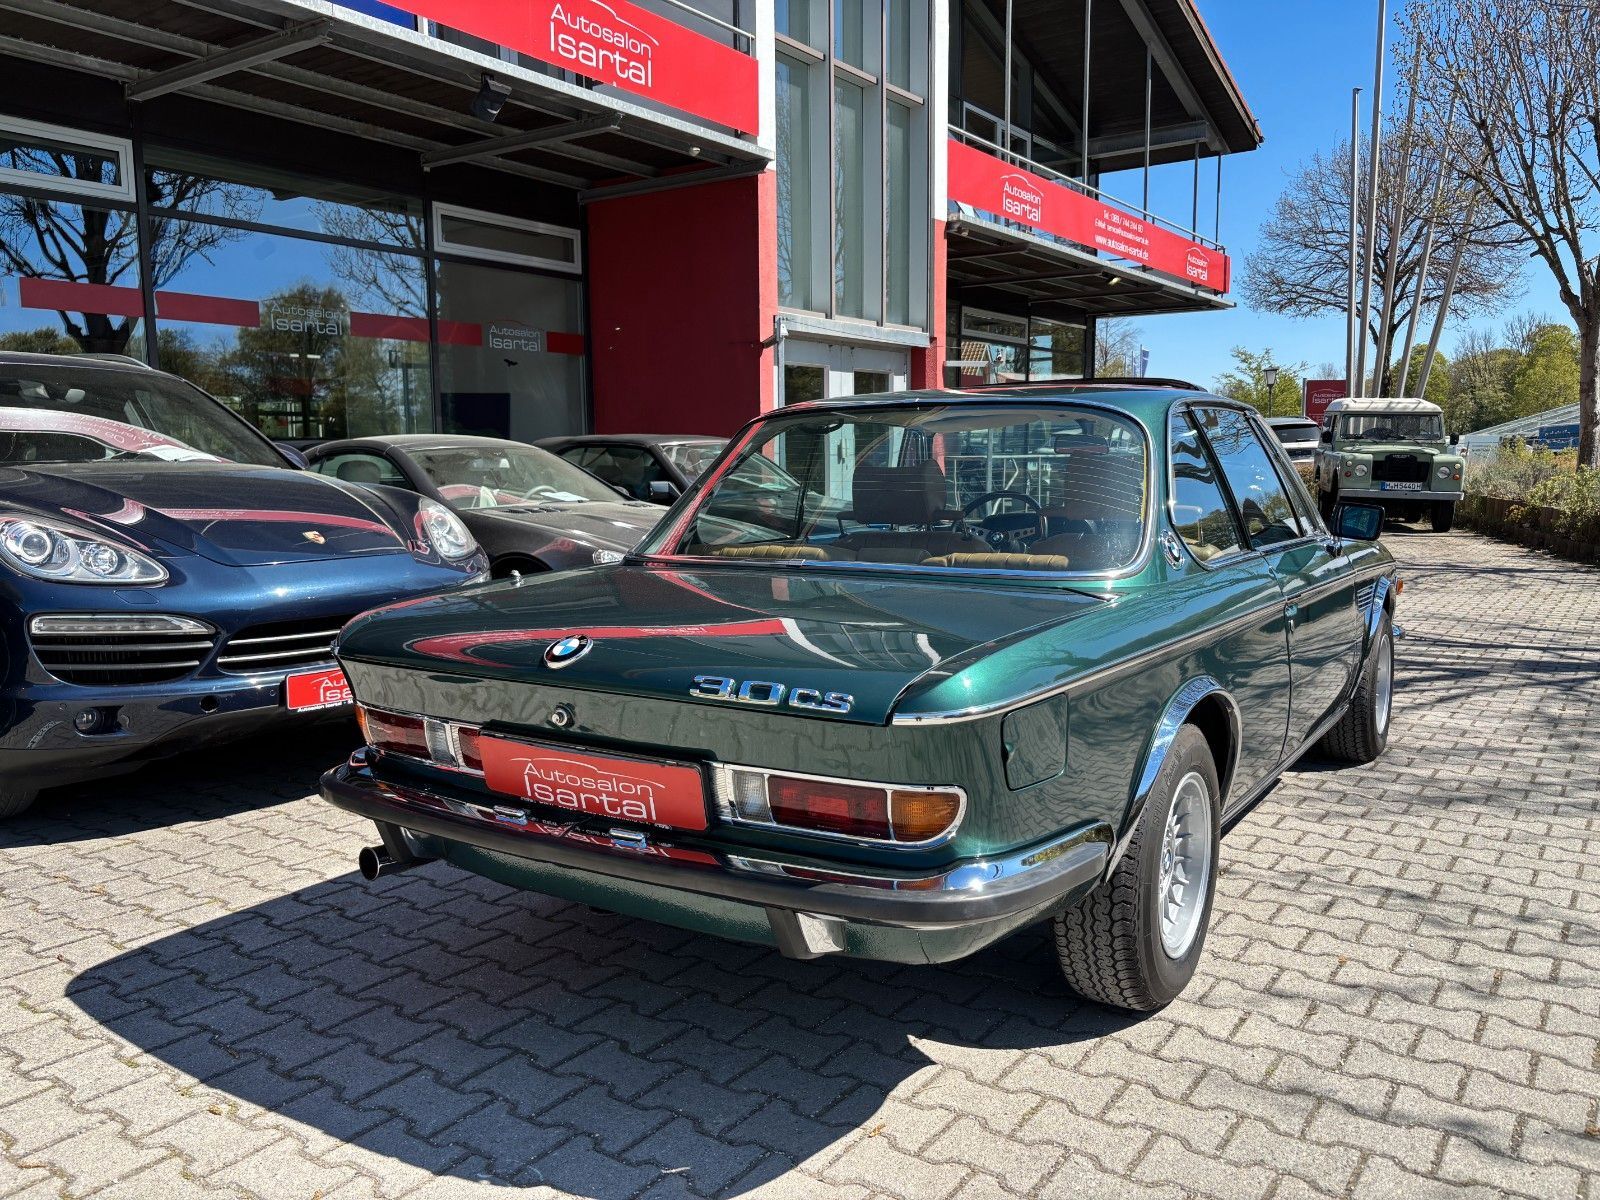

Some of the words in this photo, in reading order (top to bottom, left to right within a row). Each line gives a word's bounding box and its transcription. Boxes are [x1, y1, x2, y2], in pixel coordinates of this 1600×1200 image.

[550, 3, 652, 58] Autosalon
[550, 21, 652, 88] Isartal
[1003, 181, 1041, 205] Autosalon
[1002, 192, 1041, 223] Isartal
[1186, 262, 1208, 281] Isartal
[1187, 253, 1208, 268] Autosalon
[270, 302, 342, 320] Autosalon
[270, 313, 343, 336] Isartal
[490, 325, 541, 338] Autosalon
[489, 333, 541, 353] Isartal
[523, 762, 654, 797] Autosalon
[523, 774, 657, 821] Isartal
